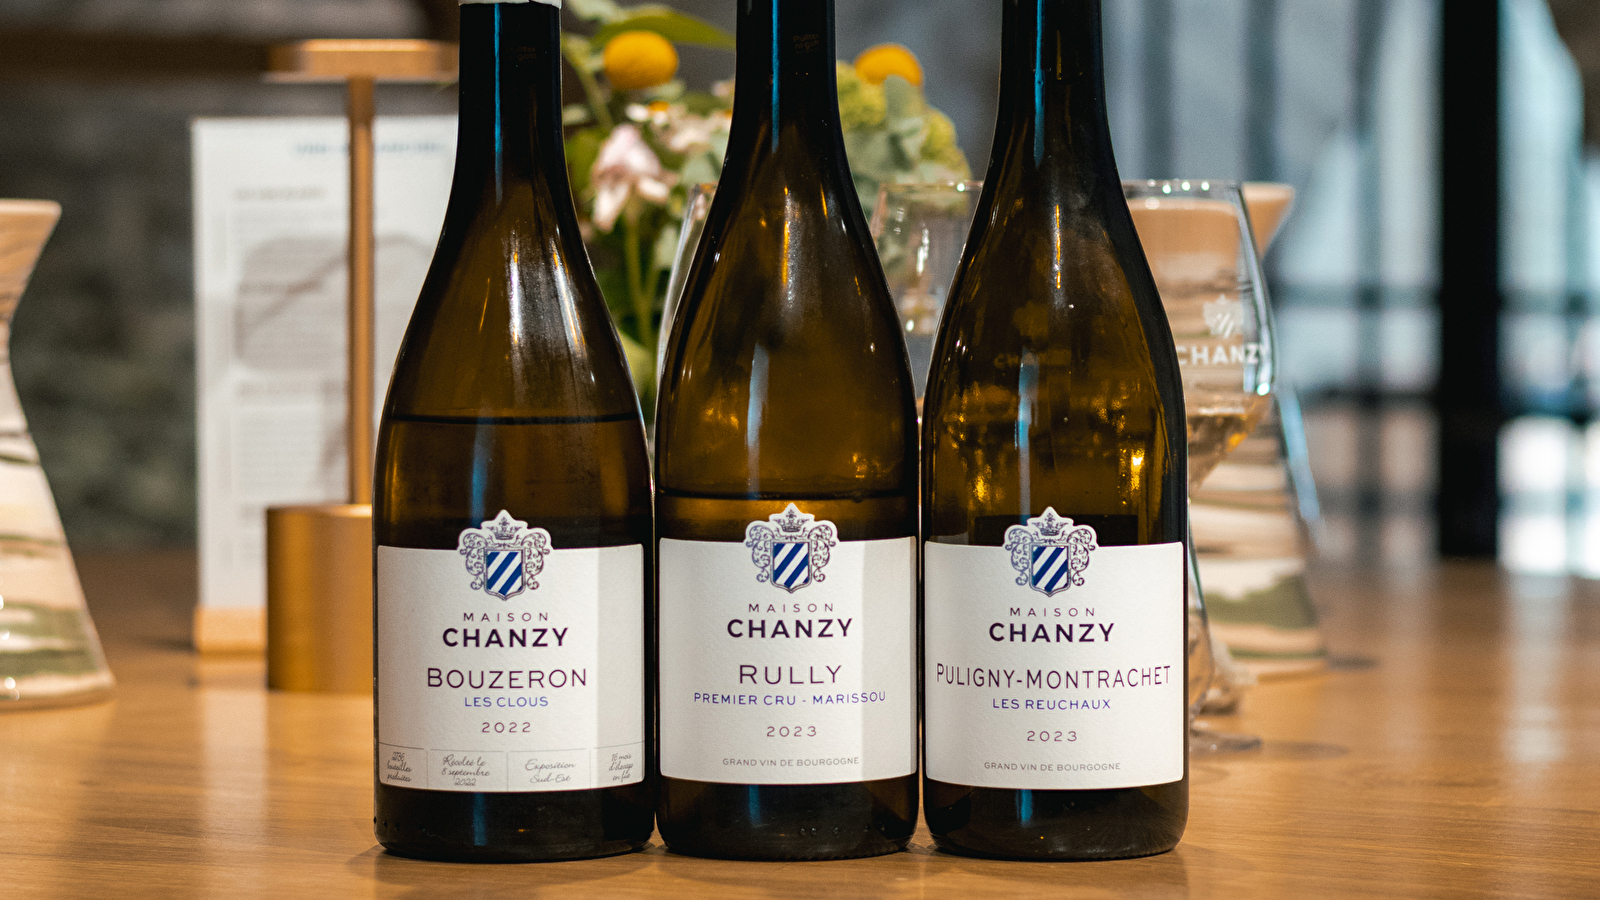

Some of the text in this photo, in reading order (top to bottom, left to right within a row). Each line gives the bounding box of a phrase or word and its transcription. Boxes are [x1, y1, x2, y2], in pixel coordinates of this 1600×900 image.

[748, 602, 834, 613] MAISON
[1009, 606, 1095, 618] MAISON
[463, 612, 548, 623] MAISON
[726, 617, 853, 639] CHANZY
[988, 622, 1115, 643] CHANZY
[442, 627, 569, 648] CHANZY
[427, 667, 587, 690] BOUZERON
[739, 664, 842, 685] RULLY
[936, 662, 1171, 690] PULIGNY-MONTRACHET
[464, 695, 549, 708] LES CLOUS
[694, 692, 758, 706] PREMIER
[763, 694, 796, 706] CRU
[812, 691, 886, 705] MARISSOU
[992, 698, 1111, 711] LES REUCHAUX
[481, 721, 531, 734] 2022
[766, 725, 817, 738] 2023
[1026, 730, 1078, 743] 2023
[476, 756, 487, 766] le
[525, 758, 577, 774] Exposition
[722, 756, 859, 768] GRAND VIN DE BOURGOGNE
[983, 761, 1121, 772] GRAND VIN DE BOURGOGNE
[448, 767, 491, 779] septembre
[530, 772, 572, 784] Sud-Est
[454, 777, 477, 787] 2022
